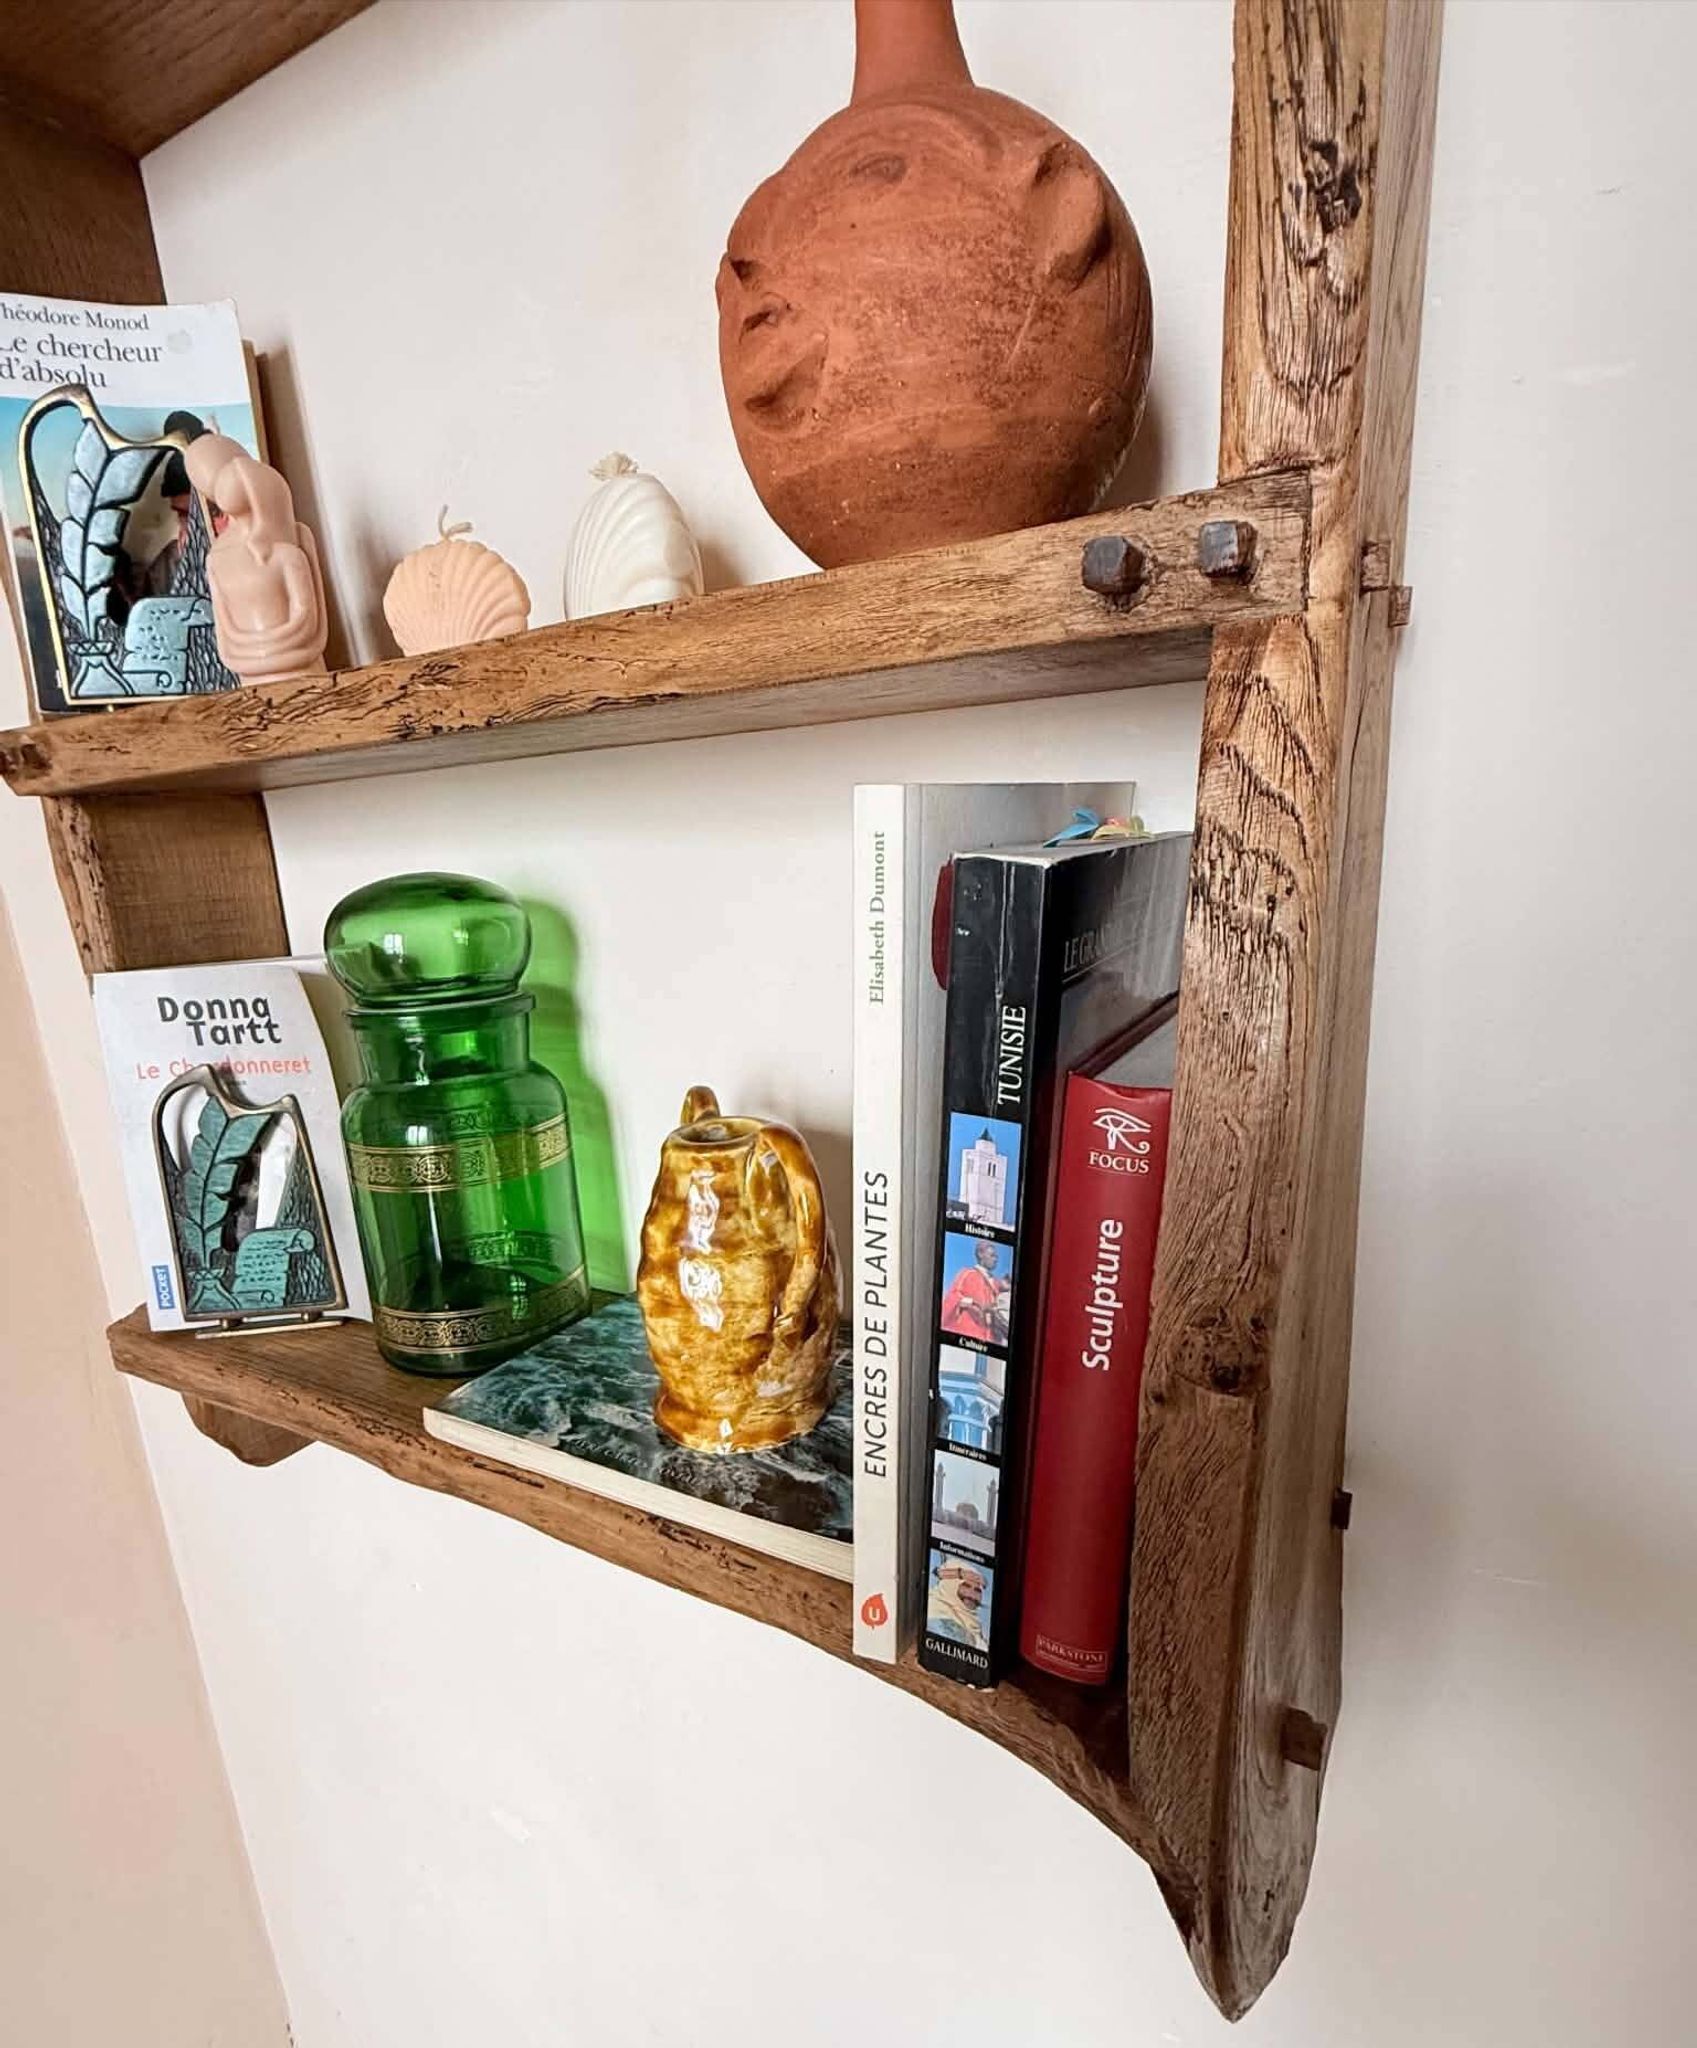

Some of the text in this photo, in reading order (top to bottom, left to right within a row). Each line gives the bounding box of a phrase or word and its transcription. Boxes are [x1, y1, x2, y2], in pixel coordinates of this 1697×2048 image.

[0, 302, 150, 330] héodore Monod
[37, 333, 164, 362] chercheur
[869, 831, 885, 1005] Elisabeth Dumont
[157, 996, 271, 1022] Donna
[186, 1016, 282, 1046] Tartt
[998, 1005, 1026, 1105] TUNISIE
[136, 1061, 160, 1080] Le
[1089, 1151, 1149, 1174] FOCUS
[155, 1267, 172, 1308] POCKET
[1082, 1219, 1123, 1371] Sculpture
[865, 1171, 888, 1477] ENCRES DE PLANTES
[958, 1337, 989, 1353] Culture
[925, 1638, 989, 1669] GALLIMARD
